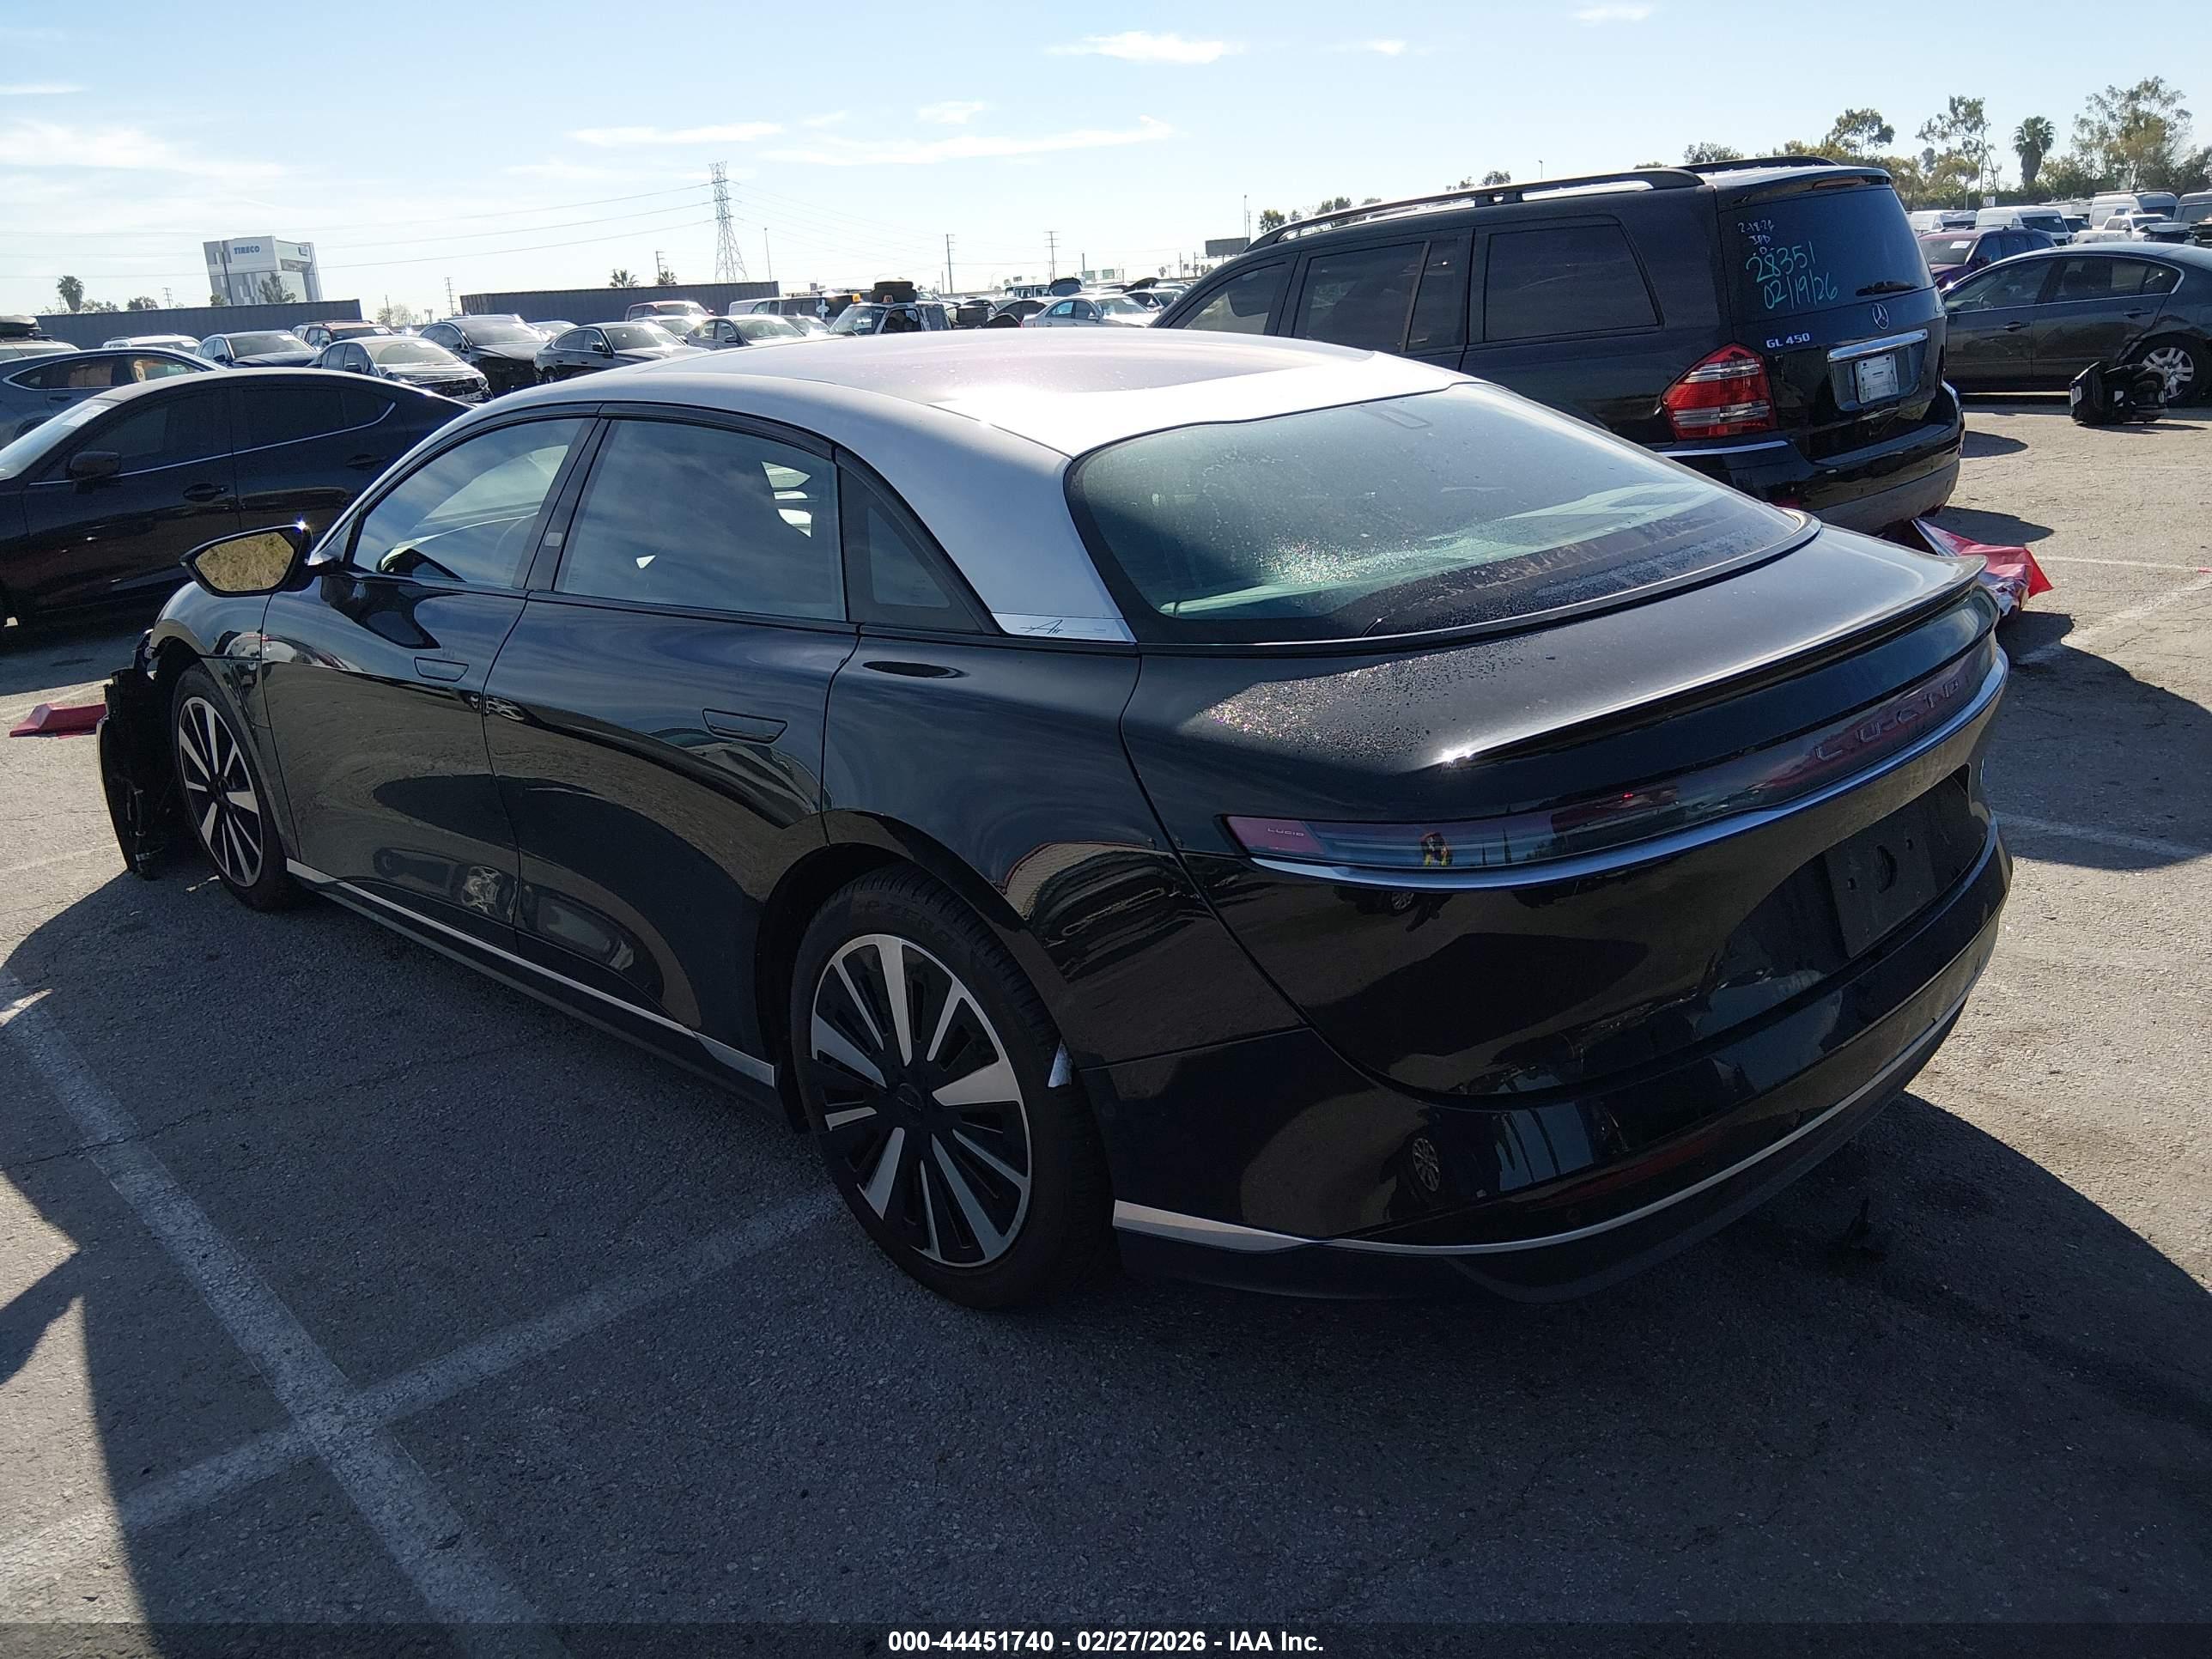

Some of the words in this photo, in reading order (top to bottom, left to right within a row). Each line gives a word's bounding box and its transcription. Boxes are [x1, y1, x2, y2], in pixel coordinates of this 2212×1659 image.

[234, 246, 260, 254] TIRECO
[1746, 241, 1815, 283] 28351
[1765, 269, 1838, 310] 02/19/26
[1766, 338, 1784, 349] GL
[1786, 332, 1811, 344] 450
[1019, 618, 1064, 635] Air
